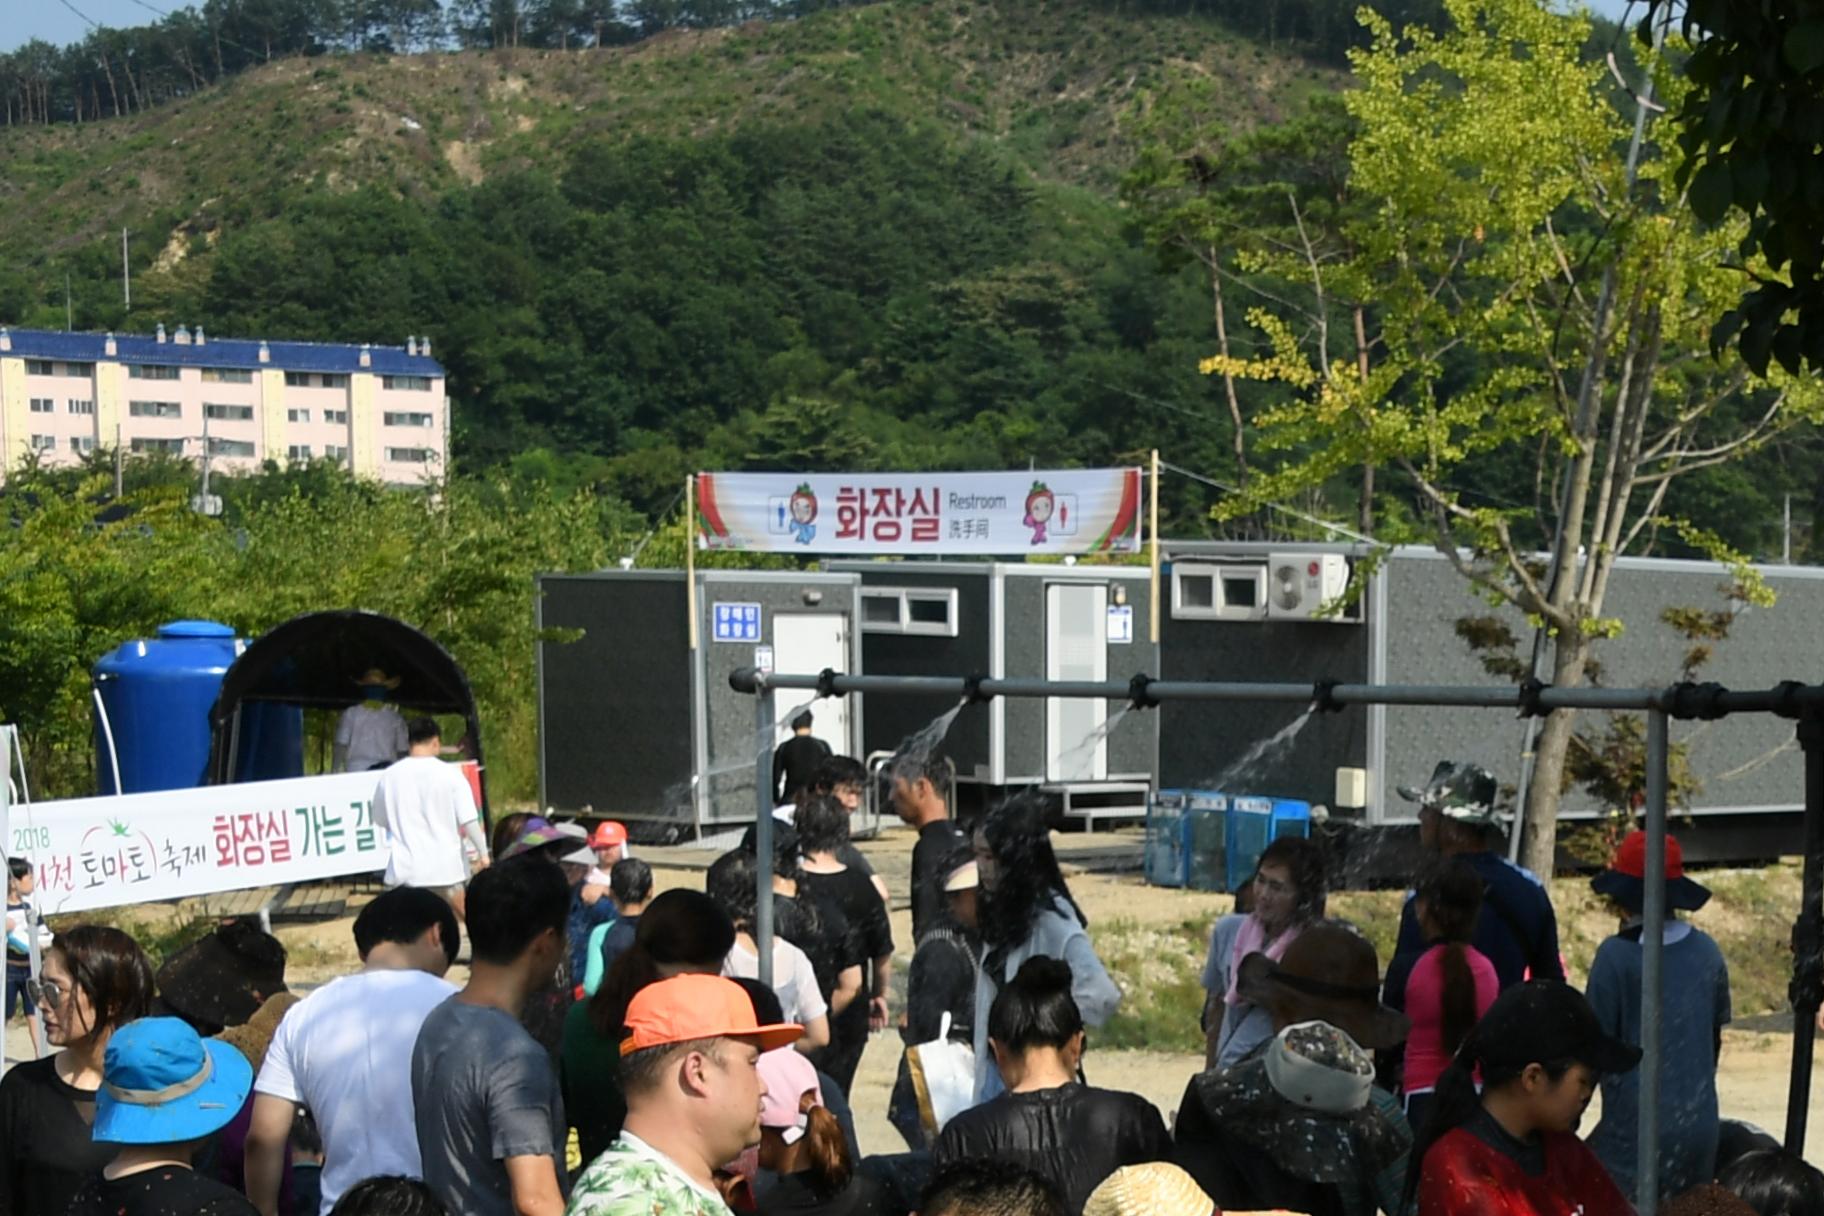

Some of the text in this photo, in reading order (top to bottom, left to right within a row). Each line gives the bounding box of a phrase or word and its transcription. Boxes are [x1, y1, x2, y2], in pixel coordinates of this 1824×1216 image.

[835, 487, 940, 542] 화장실
[949, 491, 1006, 511] Restroom
[14, 826, 50, 851] 2018
[80, 844, 153, 890] 토마토
[160, 837, 206, 879] 축제
[213, 808, 292, 868] 화장실
[295, 804, 346, 857] 가는
[350, 800, 376, 852] 길
